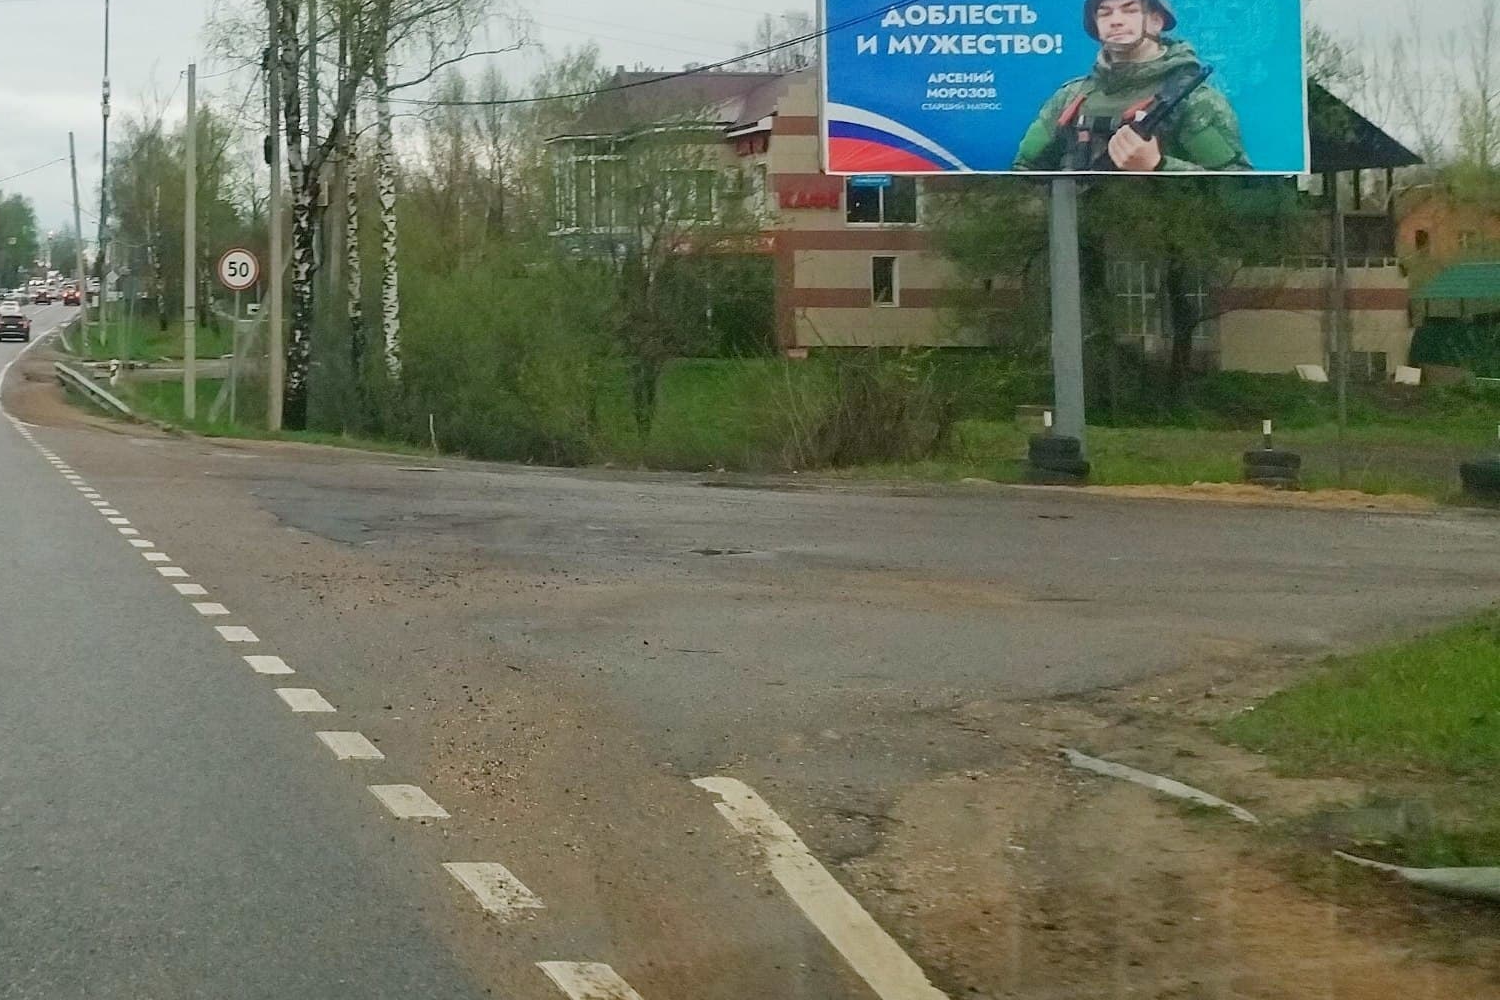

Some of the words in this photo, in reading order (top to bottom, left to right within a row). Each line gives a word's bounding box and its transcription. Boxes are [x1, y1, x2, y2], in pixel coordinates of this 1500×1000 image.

[881, 4, 1038, 28] ДОБЛЕСТЬ
[856, 34, 878, 56] И
[887, 33, 1064, 55] МУЖЕСТВО!
[927, 70, 995, 83] АРСЕНИЙ
[926, 87, 998, 99] МОРОЗОВ
[227, 261, 249, 278] 50
